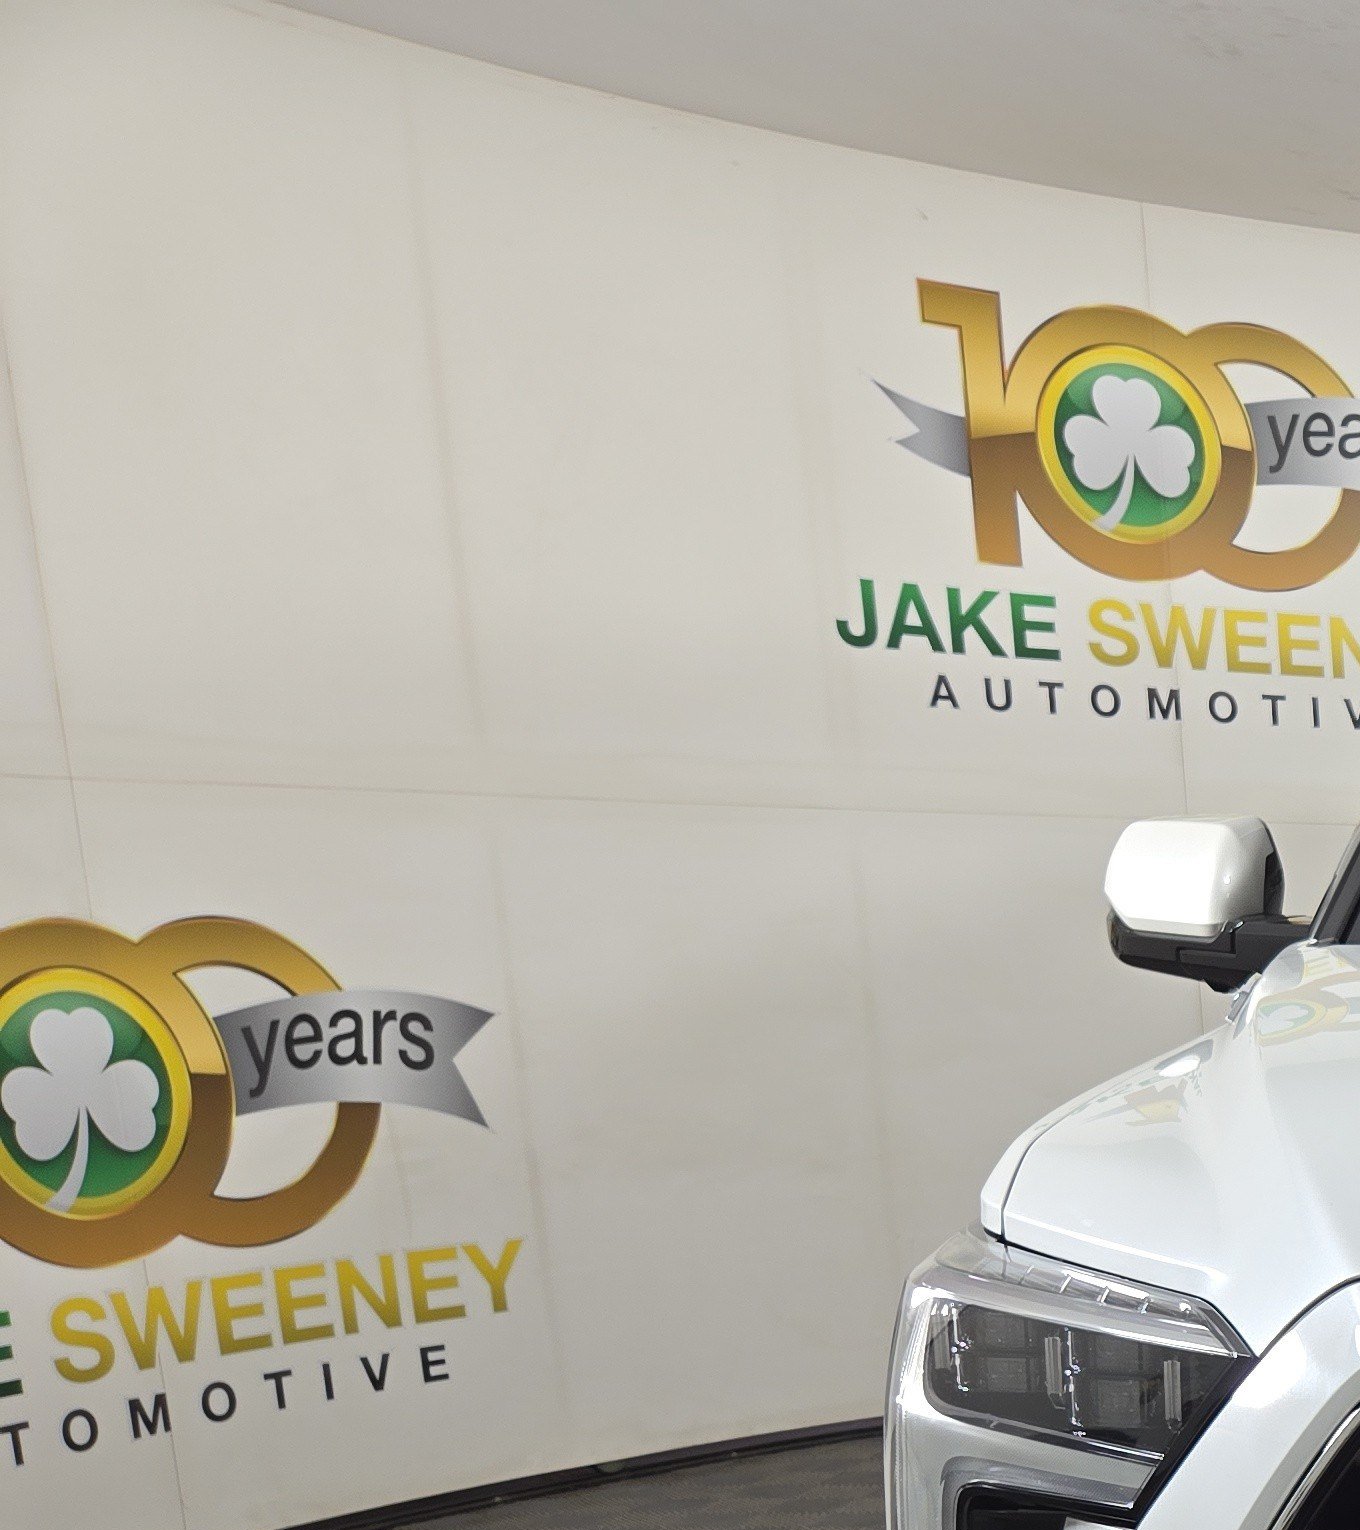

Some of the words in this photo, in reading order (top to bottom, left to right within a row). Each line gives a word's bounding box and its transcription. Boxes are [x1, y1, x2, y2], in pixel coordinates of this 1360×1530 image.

[836, 578, 1062, 661] JAKE
[242, 1009, 435, 1097] years
[50, 1239, 523, 1383] SWEENEY
[0, 1345, 449, 1466] TOMOTIVE
